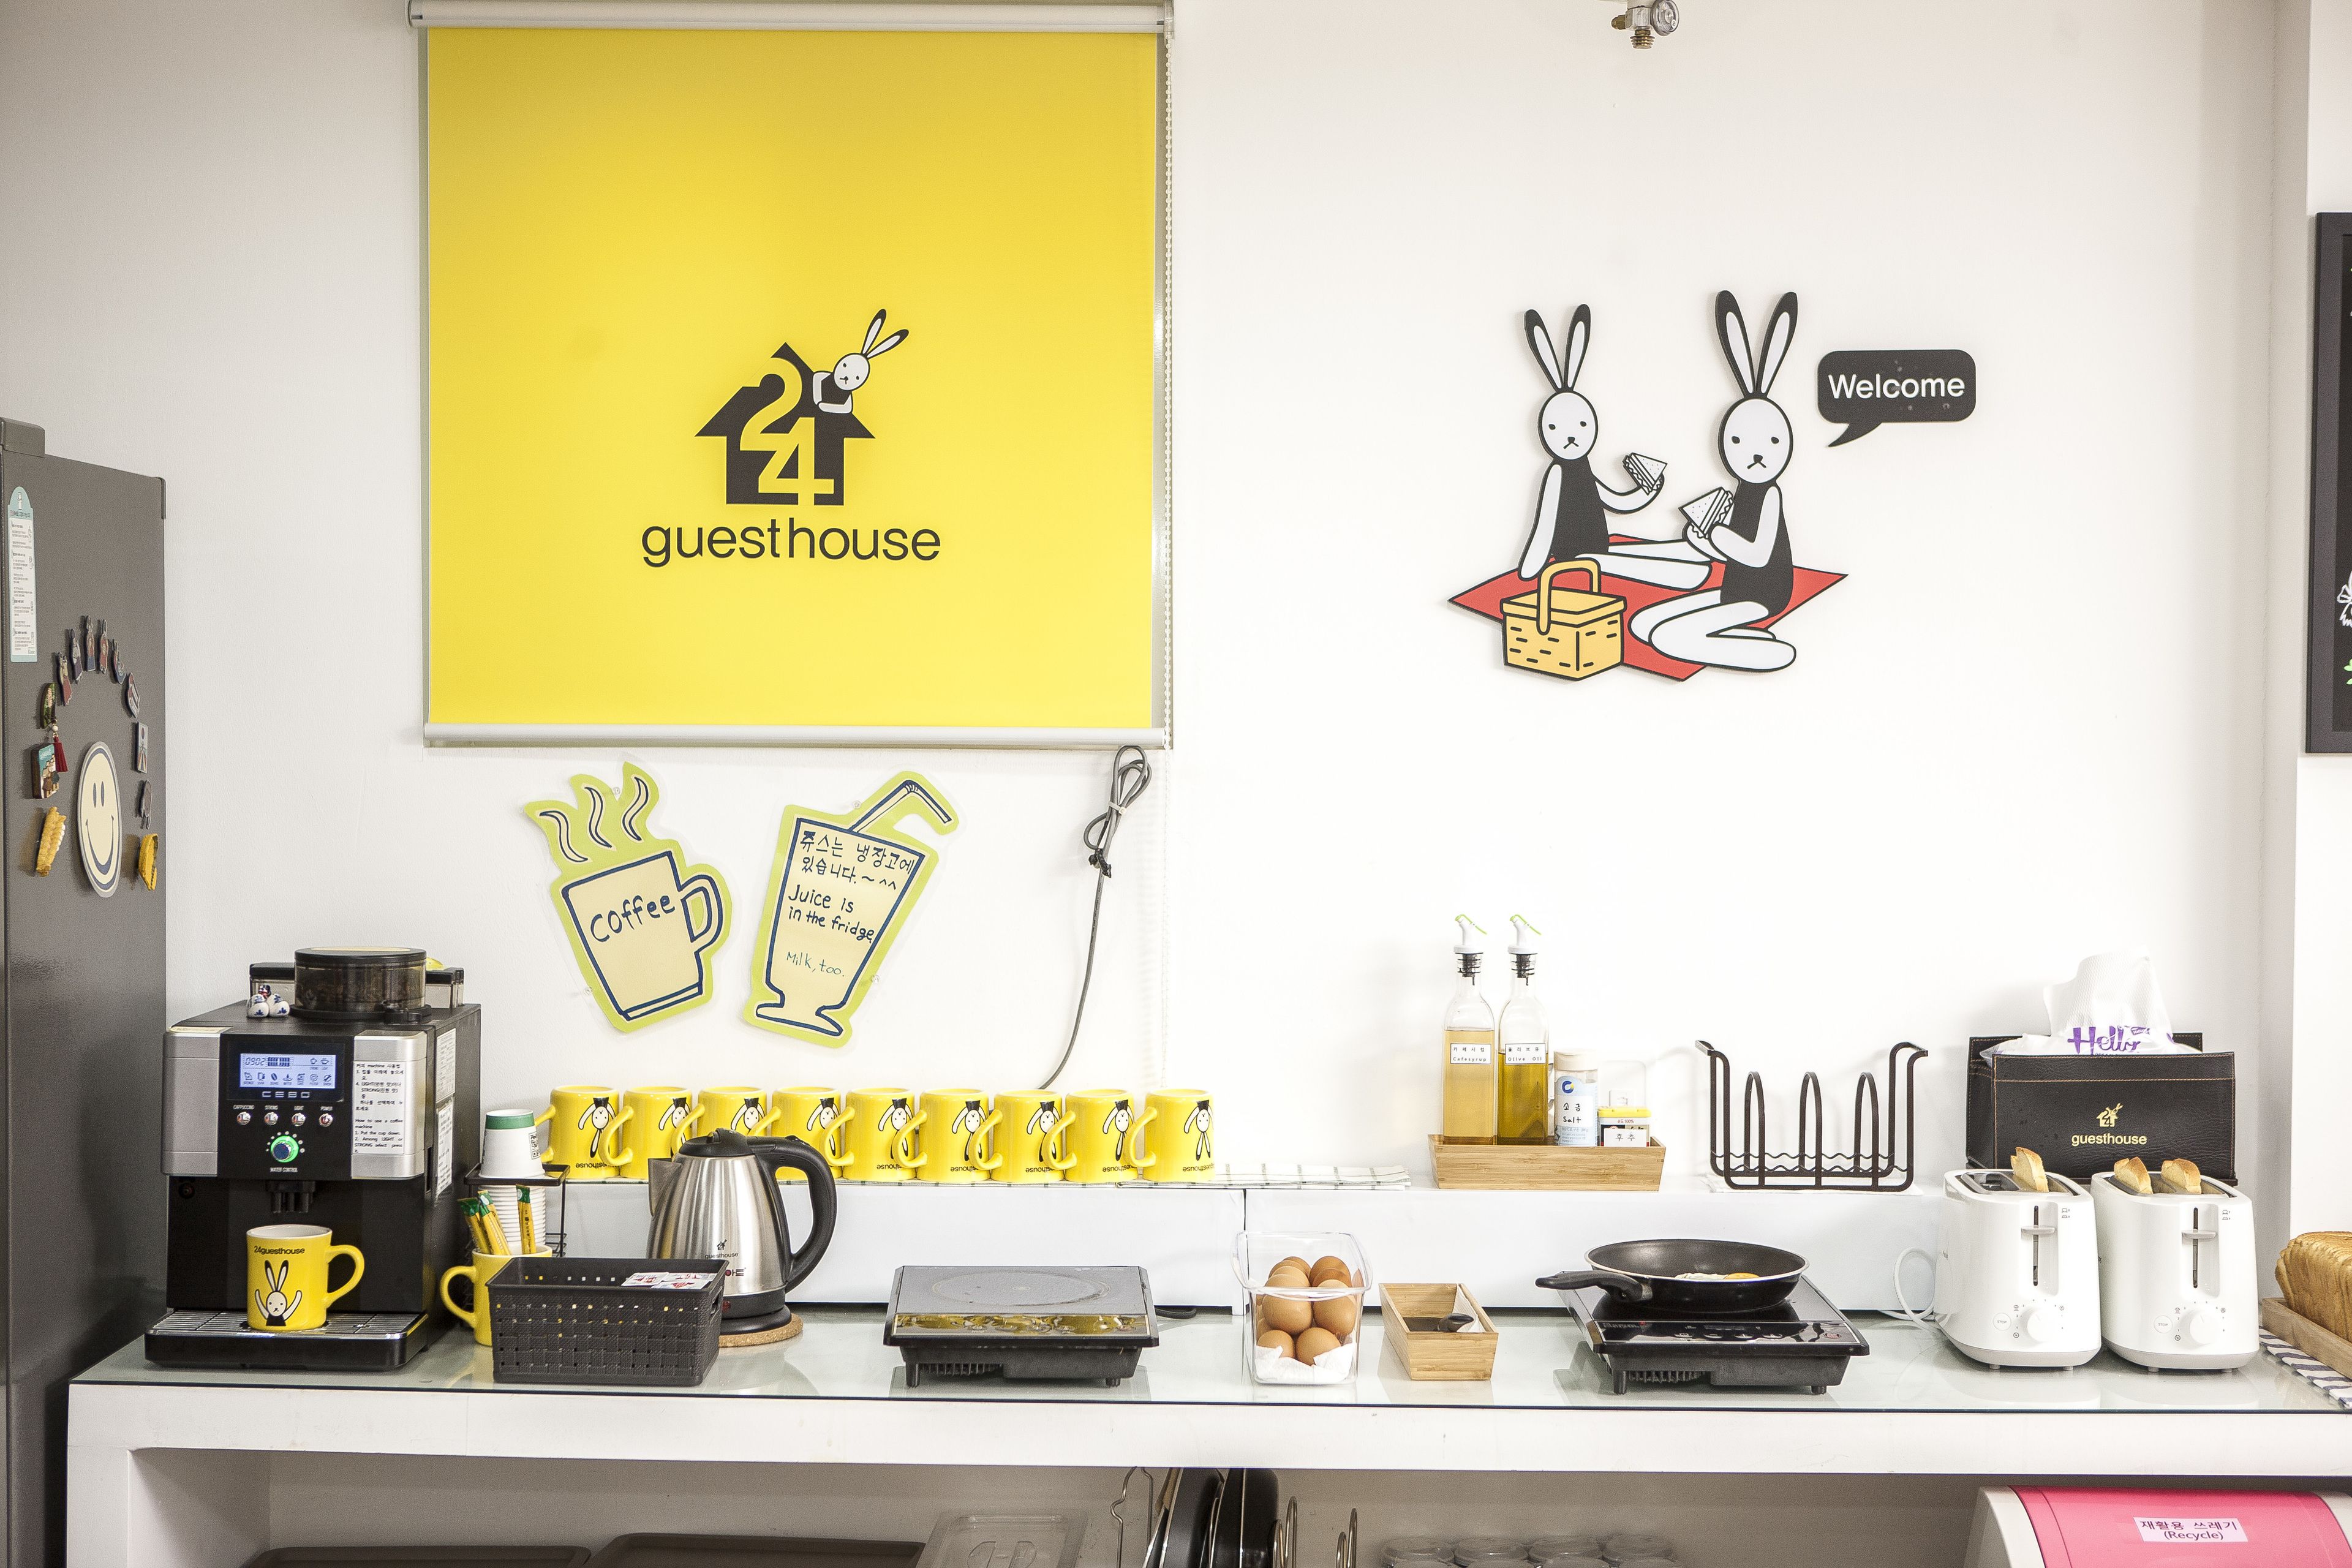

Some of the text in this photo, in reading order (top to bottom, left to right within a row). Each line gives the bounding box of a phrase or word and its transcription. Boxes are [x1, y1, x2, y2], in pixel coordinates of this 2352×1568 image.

[1828, 373, 1966, 399] Welcome
[641, 517, 941, 568] guesthouse
[856, 843, 915, 875] 냉장고에
[788, 884, 831, 908] Juice
[788, 906, 802, 922] in
[806, 910, 826, 927] the
[819, 959, 845, 977] too.
[1563, 1102, 1580, 1112] 소금
[1615, 1132, 1635, 1142] 후추
[2071, 1132, 2147, 1147] guesthouse
[254, 1245, 306, 1255] 24guesthouse
[2139, 1521, 2237, 1531] 재활용 쓰레기
[2164, 1531, 2224, 1541] (Recycle)
